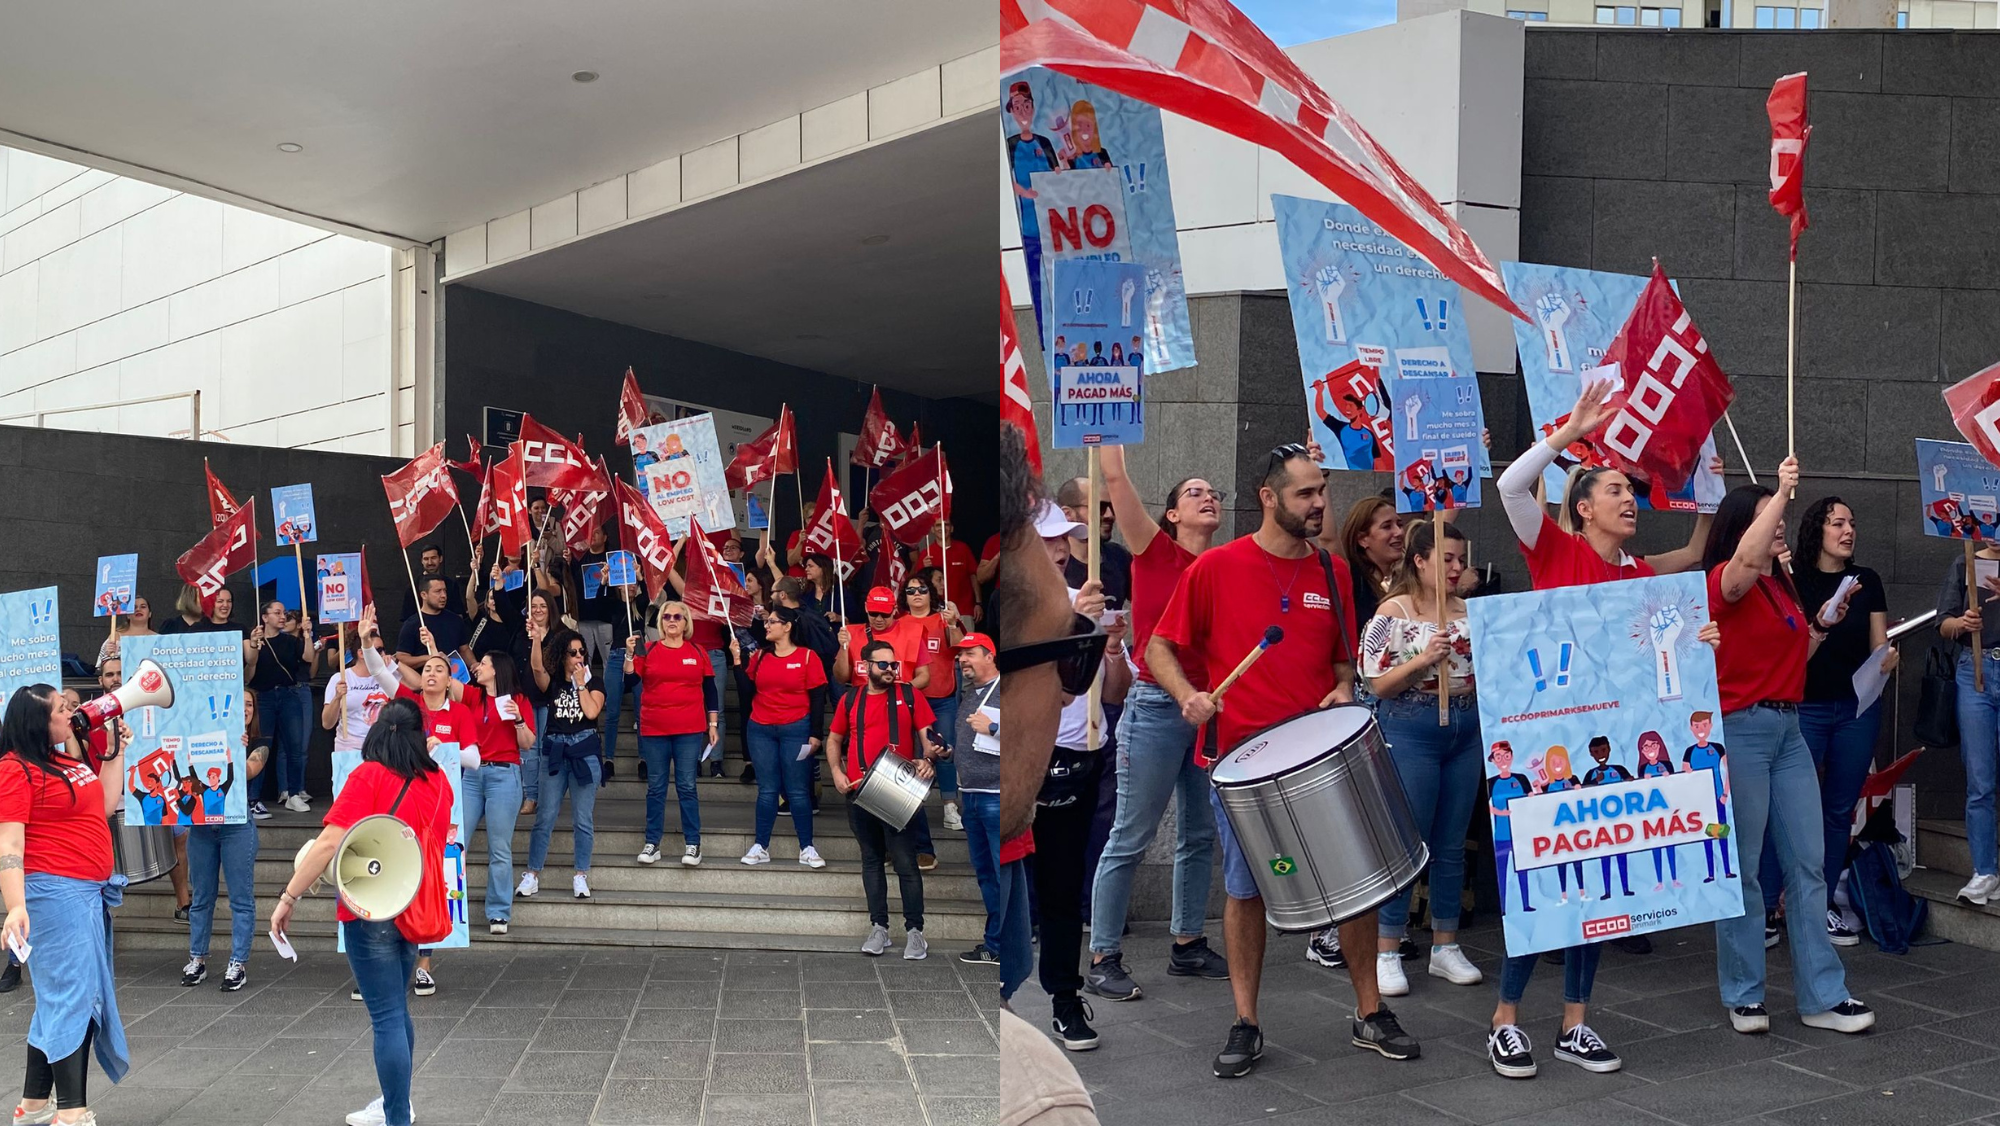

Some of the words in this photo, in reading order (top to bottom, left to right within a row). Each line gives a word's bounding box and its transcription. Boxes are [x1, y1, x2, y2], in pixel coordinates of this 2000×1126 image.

[1048, 204, 1115, 252] NO
[1323, 218, 1370, 235] Donde
[1332, 240, 1403, 257] necesidad
[1374, 263, 1391, 274] un
[1401, 359, 1438, 367] DERECHO
[1077, 372, 1121, 385] AHORA
[1068, 387, 1107, 400] PAGAD
[1110, 385, 1133, 398] MÁS
[1422, 432, 1439, 440] final
[1452, 431, 1477, 439] sueldo
[653, 470, 691, 493] NO
[657, 498, 675, 507] LOW
[676, 494, 695, 503] COST
[326, 583, 345, 594] NO
[11, 638, 26, 647] Me
[28, 634, 56, 645] sobra
[0, 653, 25, 662] ucho
[28, 650, 49, 659] mes
[152, 647, 184, 656] Donde
[186, 645, 216, 654] existe
[218, 644, 236, 653] una
[207, 657, 237, 667] existe
[9, 667, 22, 677] de
[25, 663, 58, 675] sueldo
[182, 674, 195, 682] un
[197, 671, 237, 681] derecho
[142, 672, 157, 688] STOP
[557, 698, 580, 708] LOVE
[556, 708, 581, 718] BACK
[1501, 700, 1620, 724] #CCOOPRIMARKSEMUEVE
[1553, 788, 1669, 827] AHORA
[204, 815, 224, 823] CCOO
[1532, 823, 1634, 858] PAGAD
[1642, 808, 1703, 840] MÁS
[1584, 917, 1629, 936] CCOO
[1630, 907, 1678, 923] servicios
[1631, 918, 1662, 931] primark
